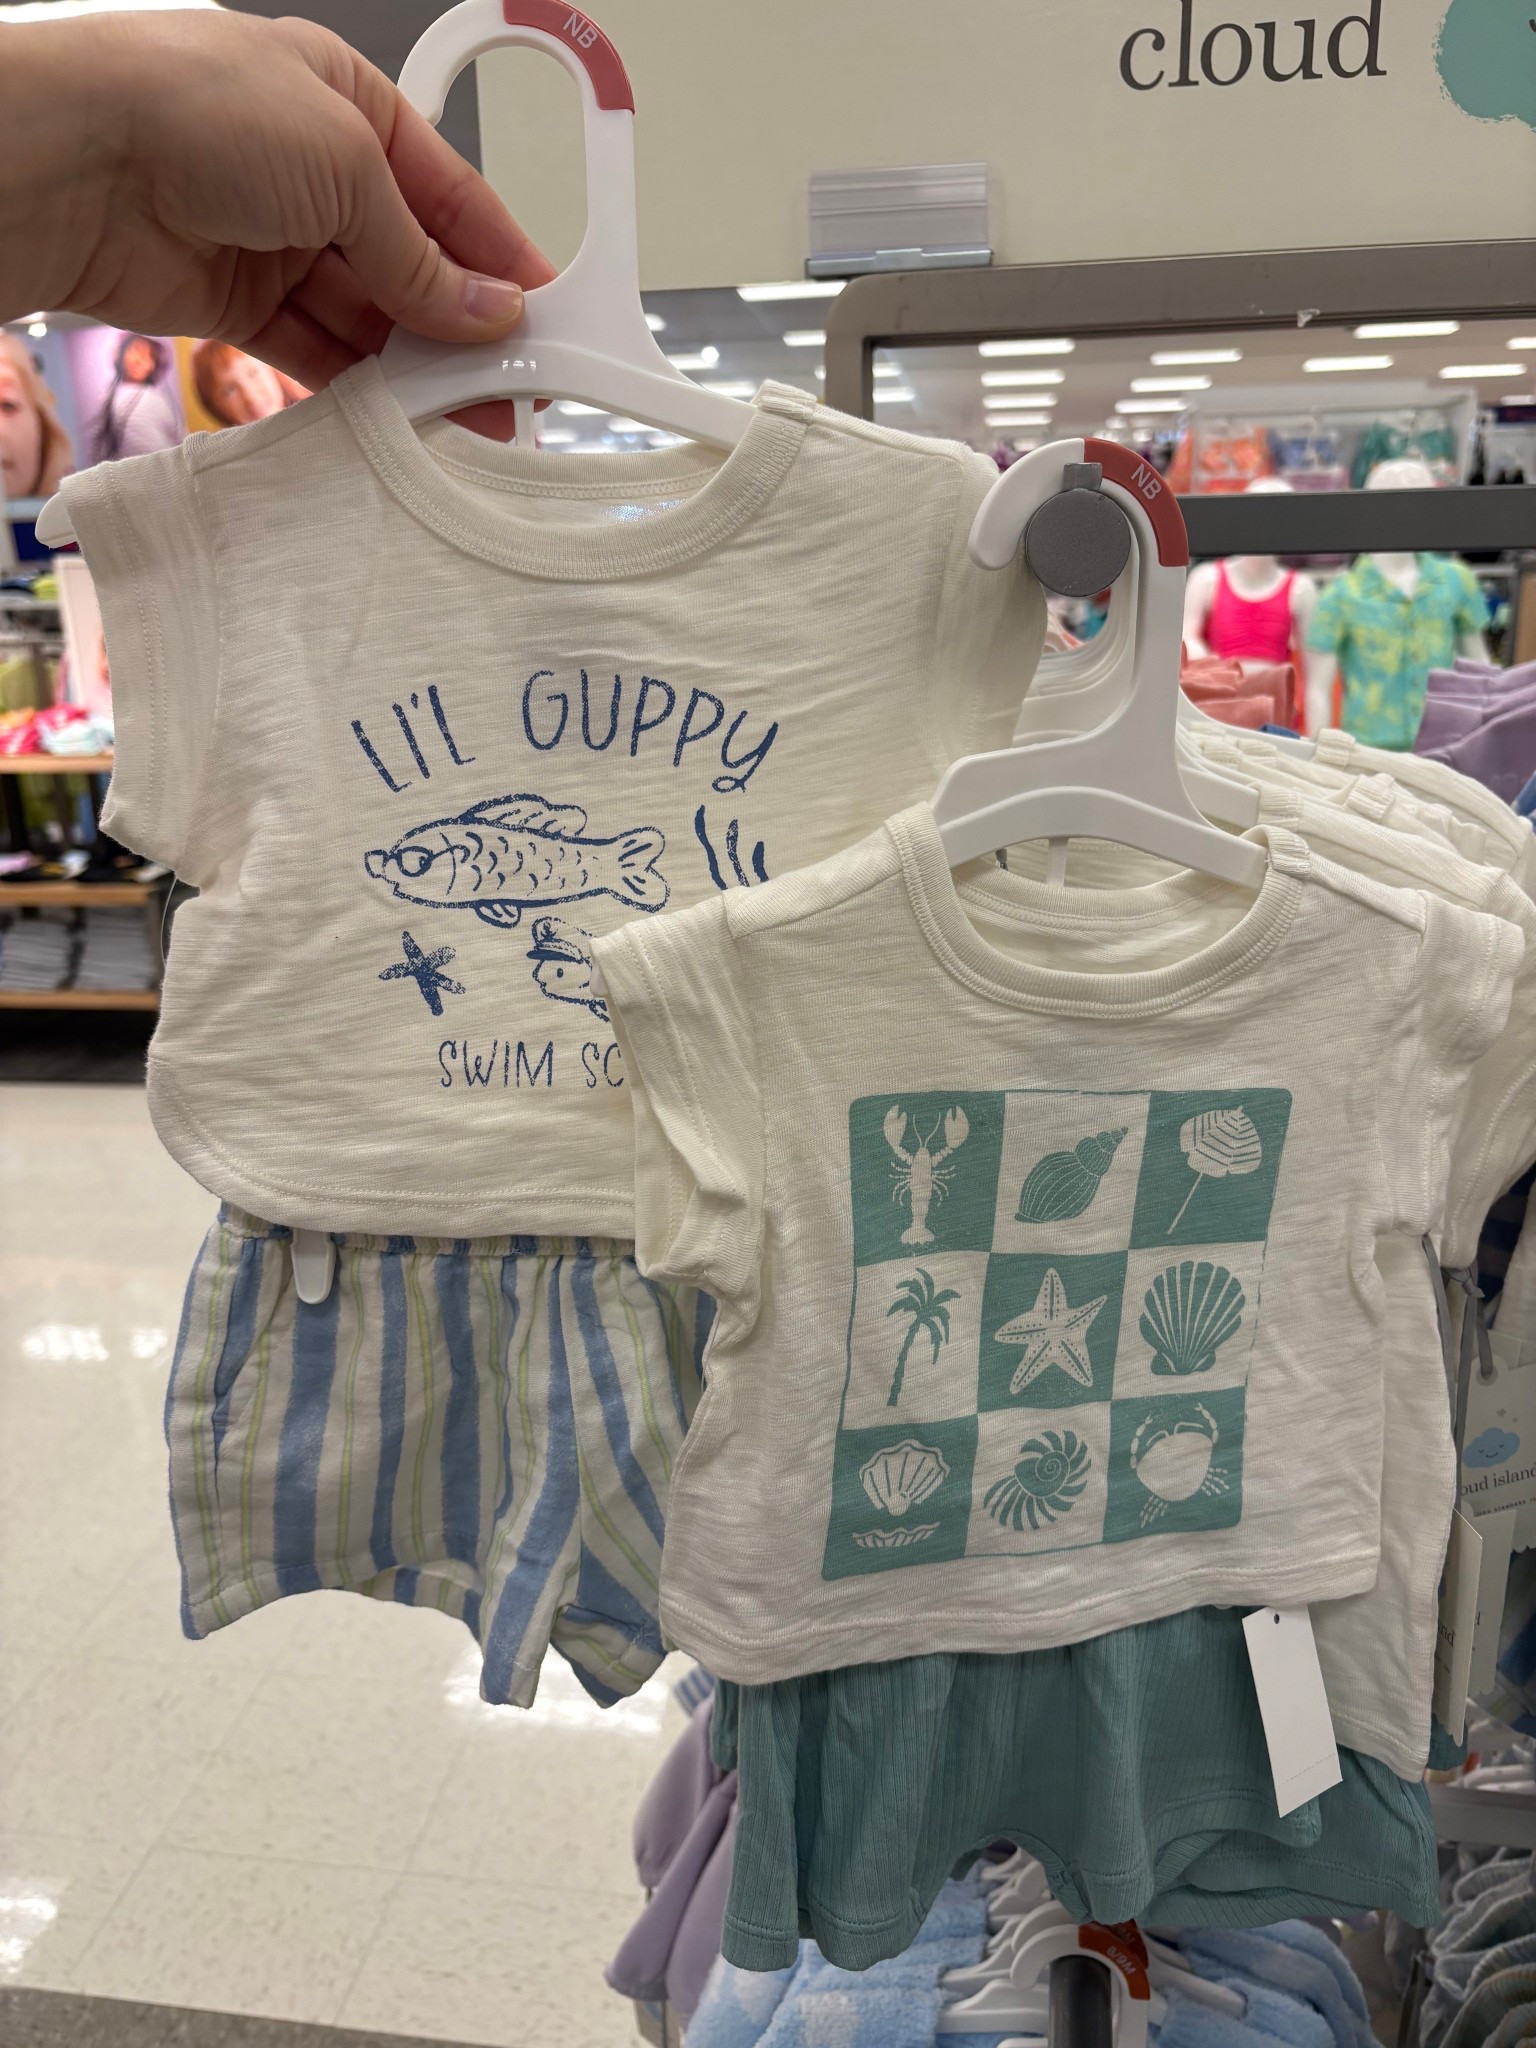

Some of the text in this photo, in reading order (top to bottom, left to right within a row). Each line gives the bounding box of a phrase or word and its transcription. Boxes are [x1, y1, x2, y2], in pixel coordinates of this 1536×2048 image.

[562, 12, 598, 49] NB
[1119, 0, 1388, 91] cloud
[1130, 463, 1162, 500] NB
[438, 1039, 554, 1088] SWIM
